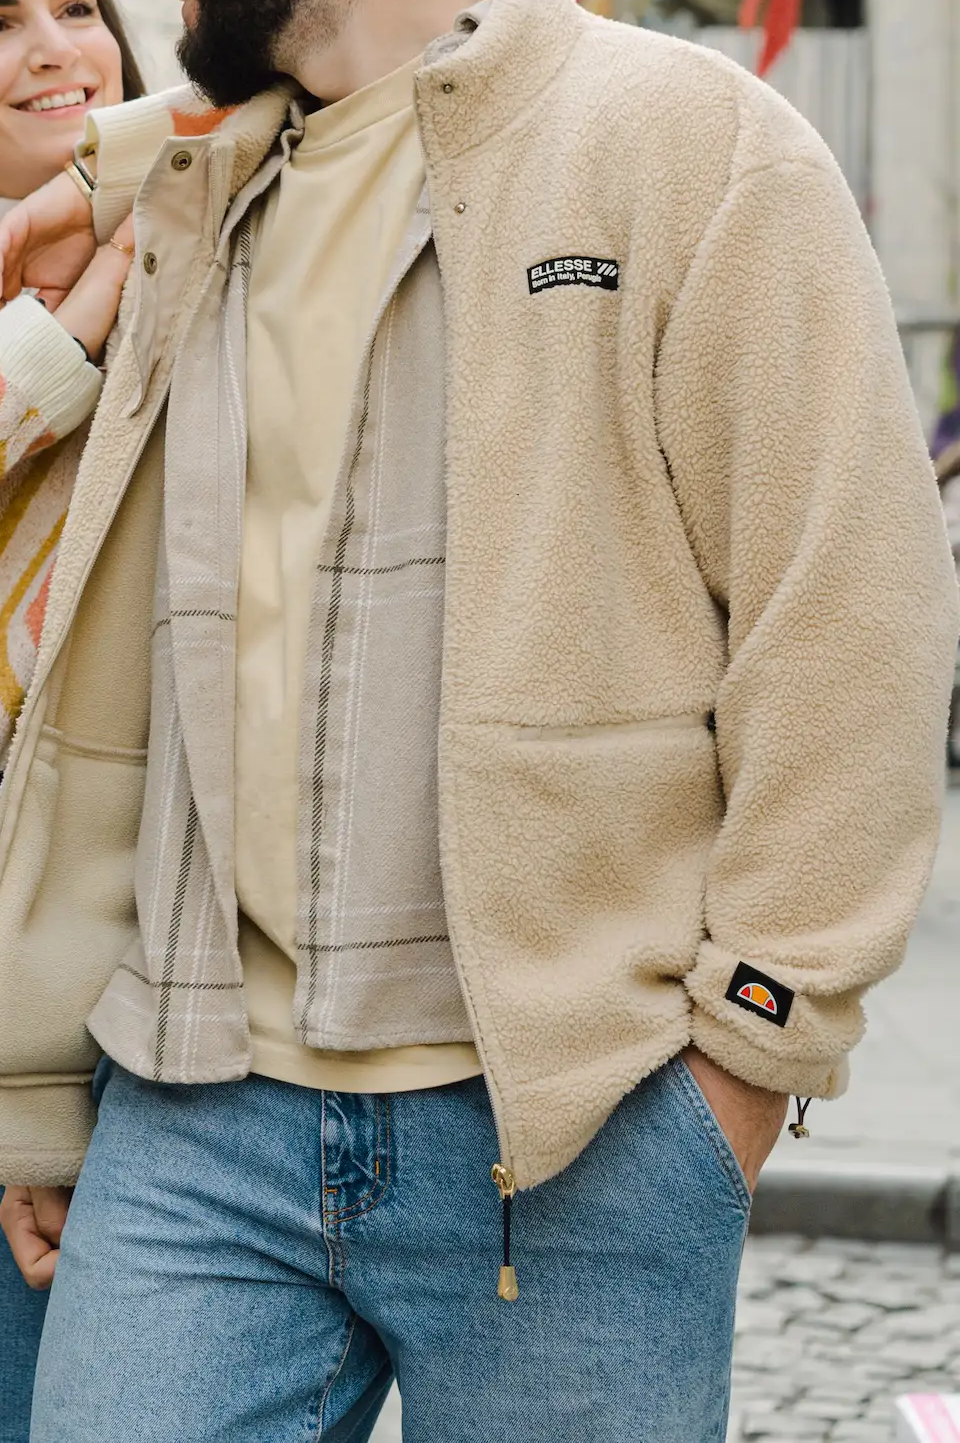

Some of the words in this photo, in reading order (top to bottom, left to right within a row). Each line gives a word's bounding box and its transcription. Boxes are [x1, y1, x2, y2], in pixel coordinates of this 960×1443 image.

[531, 259, 592, 279] ELLESSE
[532, 278, 548, 288] Born
[548, 274, 555, 282] in
[557, 272, 575, 281] Italy,
